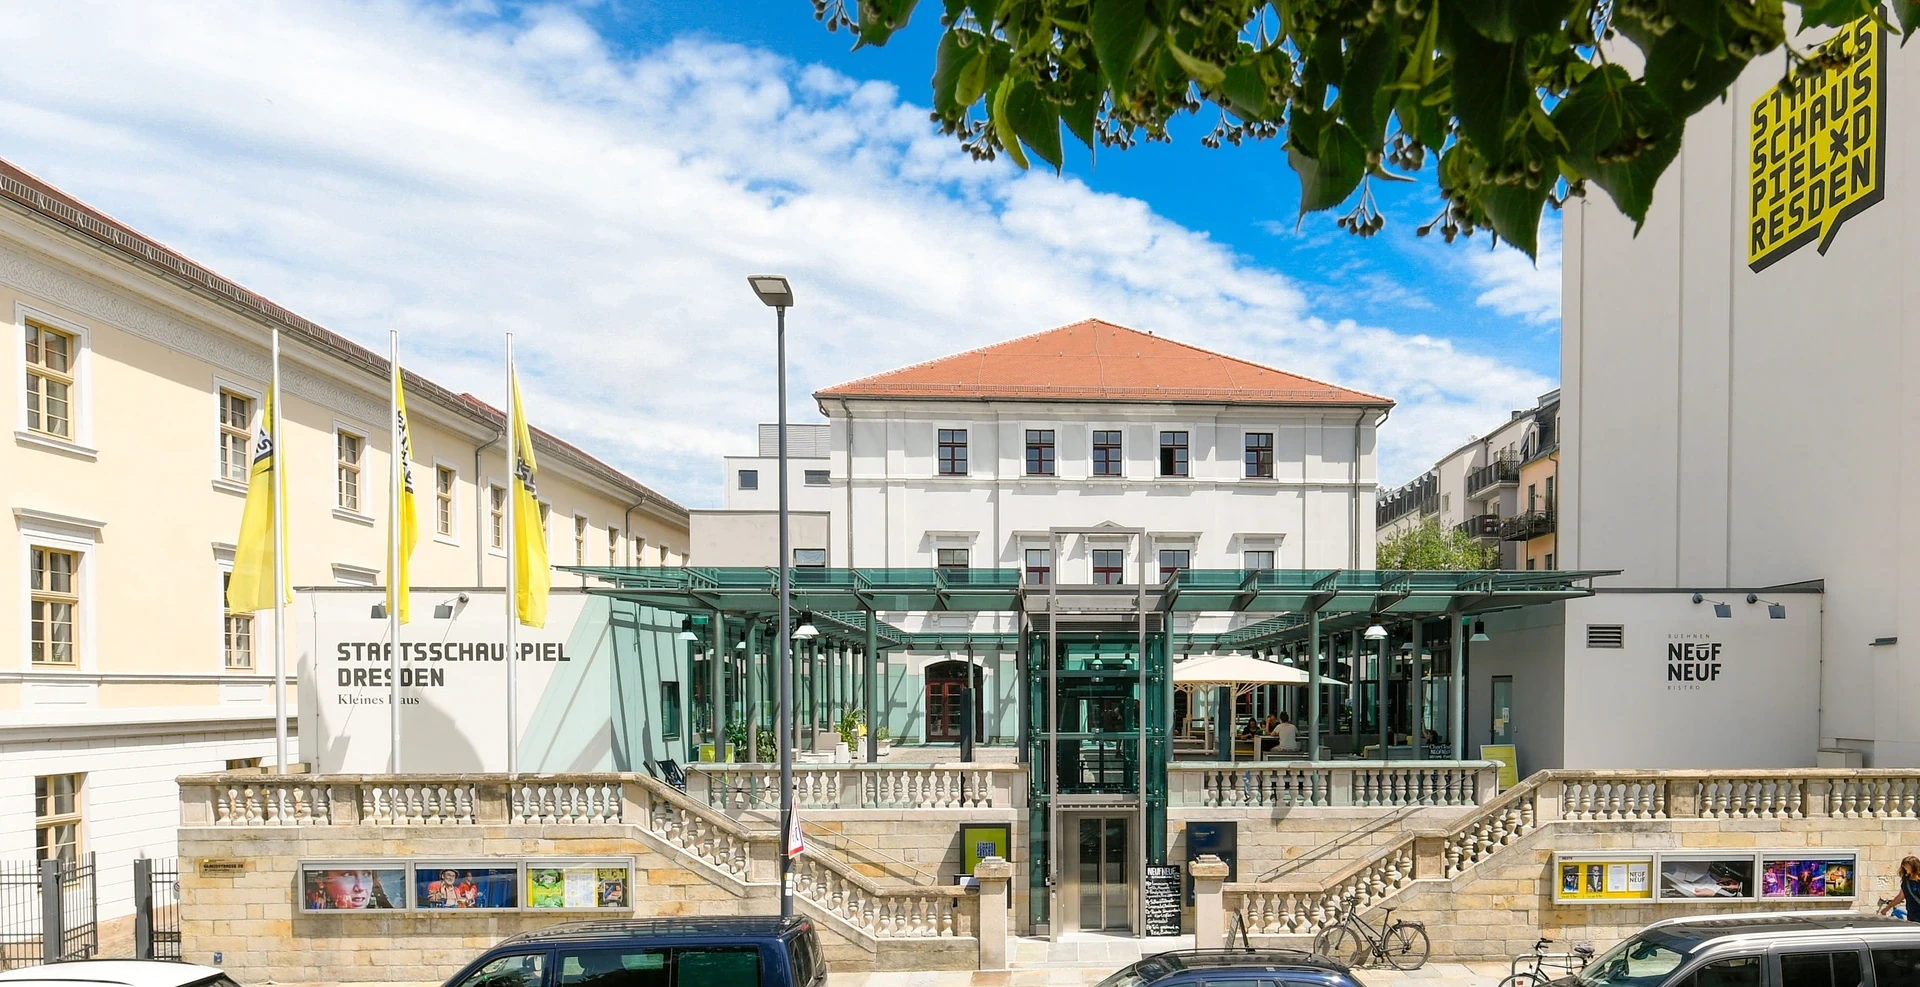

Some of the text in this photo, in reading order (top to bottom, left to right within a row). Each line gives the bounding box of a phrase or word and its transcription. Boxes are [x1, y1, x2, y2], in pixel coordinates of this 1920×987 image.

[1753, 16, 1872, 141] STAS
[1753, 58, 1872, 180] SCHAUS
[1751, 146, 1871, 257] RESDEN
[337, 642, 571, 661] STAATSSCHAUPIEL
[1668, 643, 1722, 661] NEUF
[1667, 663, 1722, 681] NEUF
[338, 694, 420, 705] Kleines aus
